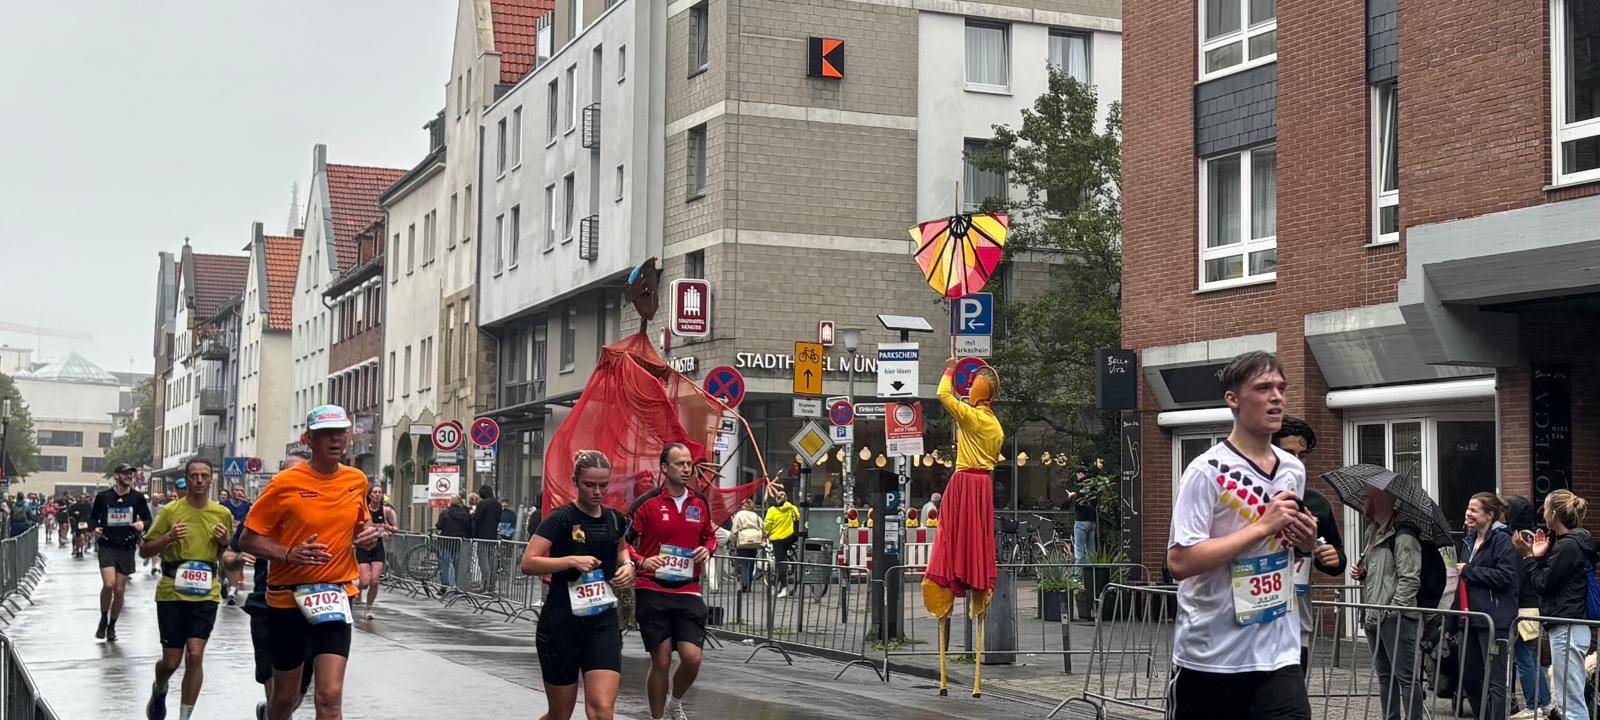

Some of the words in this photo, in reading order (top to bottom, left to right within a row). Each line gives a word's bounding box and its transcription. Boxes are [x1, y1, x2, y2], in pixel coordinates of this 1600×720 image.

[960, 299, 982, 330] P
[879, 351, 918, 359] PARKSCHEIN
[896, 367, 912, 375] lösen
[438, 430, 456, 443] 30
[886, 493, 895, 507] P
[182, 570, 208, 582] 4693
[1249, 572, 1282, 596] 358
[304, 592, 340, 607] 4702
